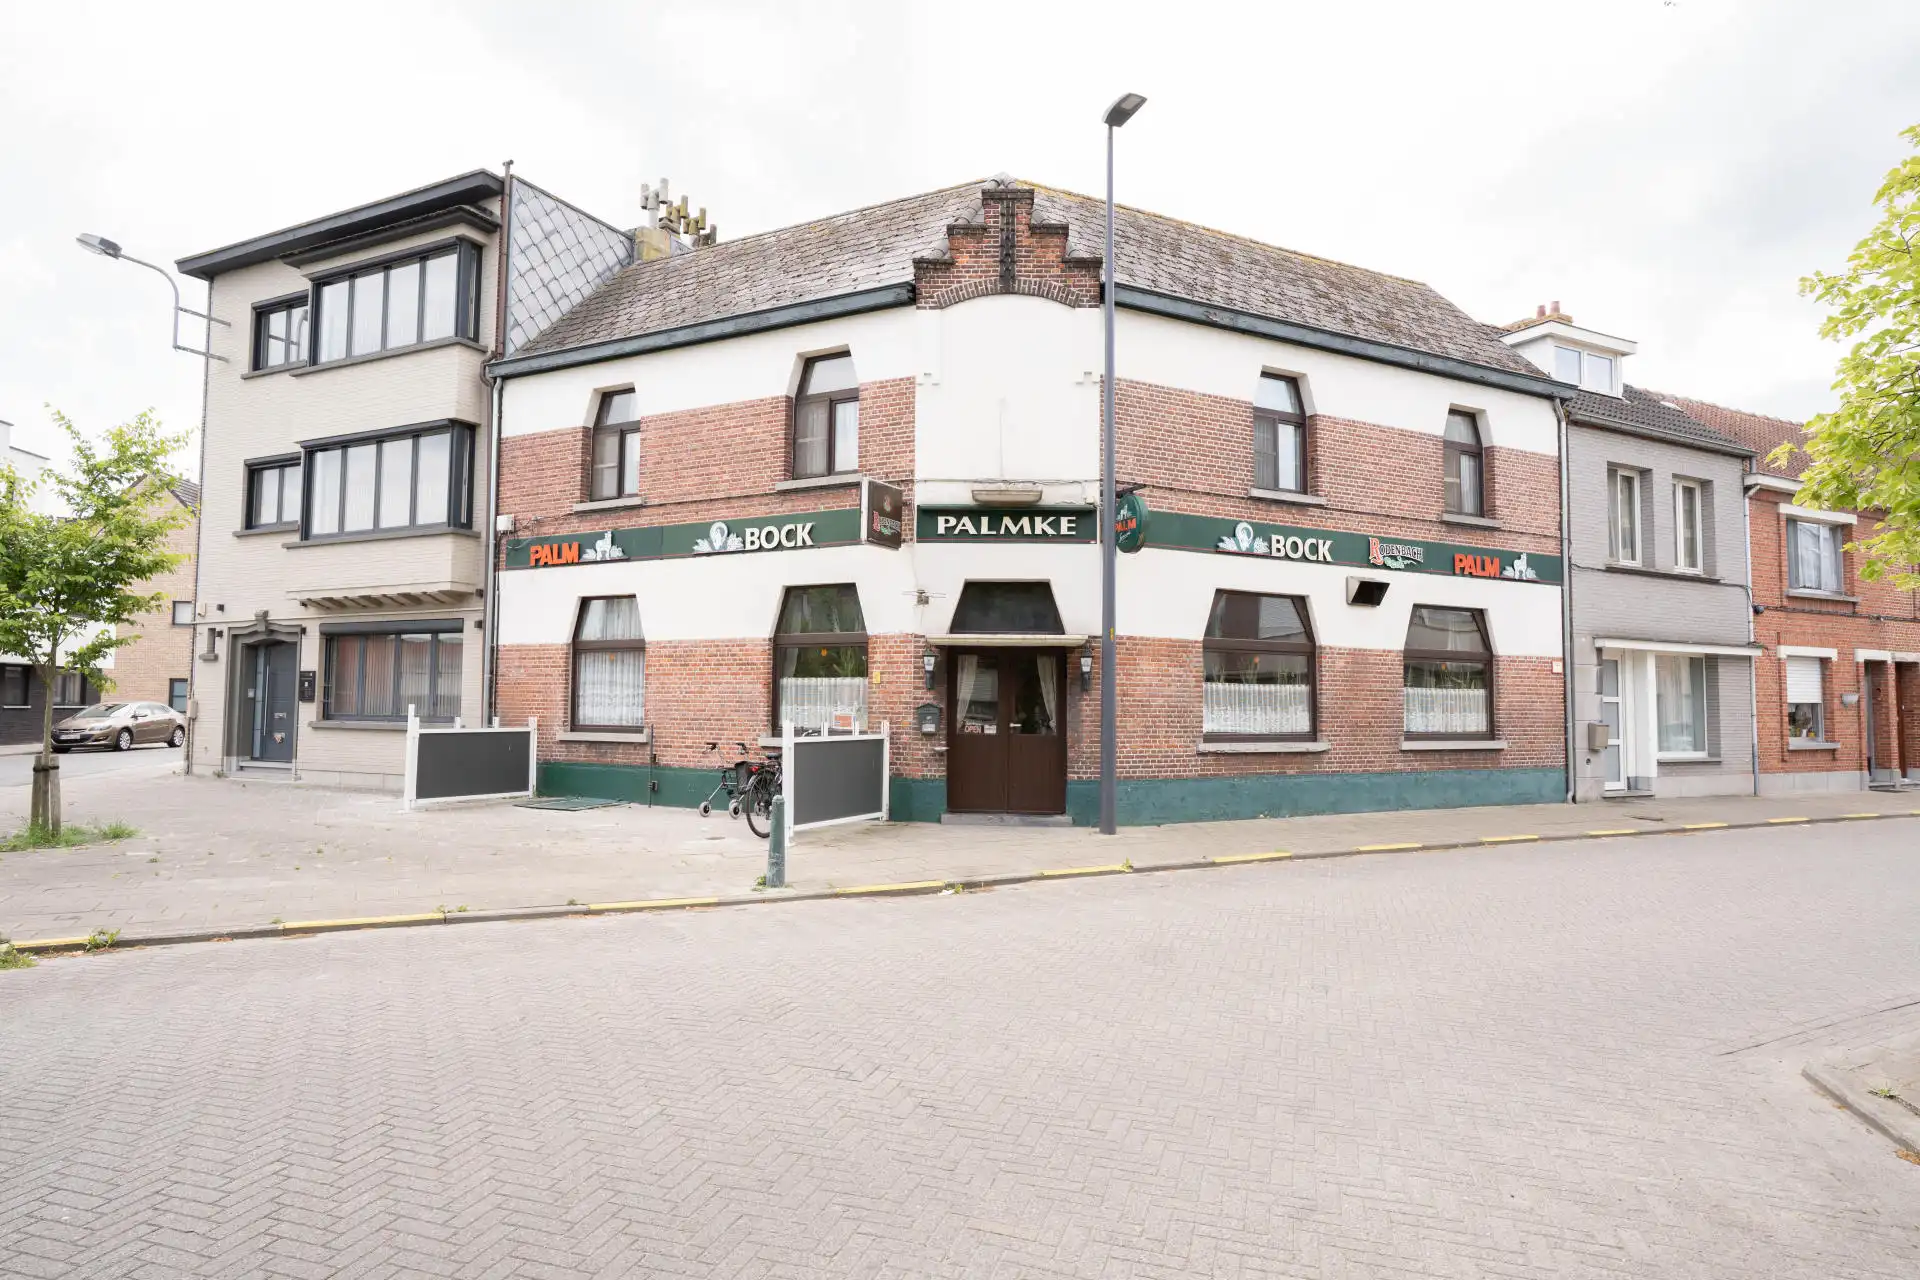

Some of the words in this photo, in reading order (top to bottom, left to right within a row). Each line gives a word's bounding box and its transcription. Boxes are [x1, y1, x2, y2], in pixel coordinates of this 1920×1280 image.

[745, 522, 815, 551] BOCK
[937, 516, 1077, 535] PALMKE
[529, 542, 580, 567] PALM
[1271, 534, 1334, 562] BOCK
[1454, 553, 1500, 577] PALM
